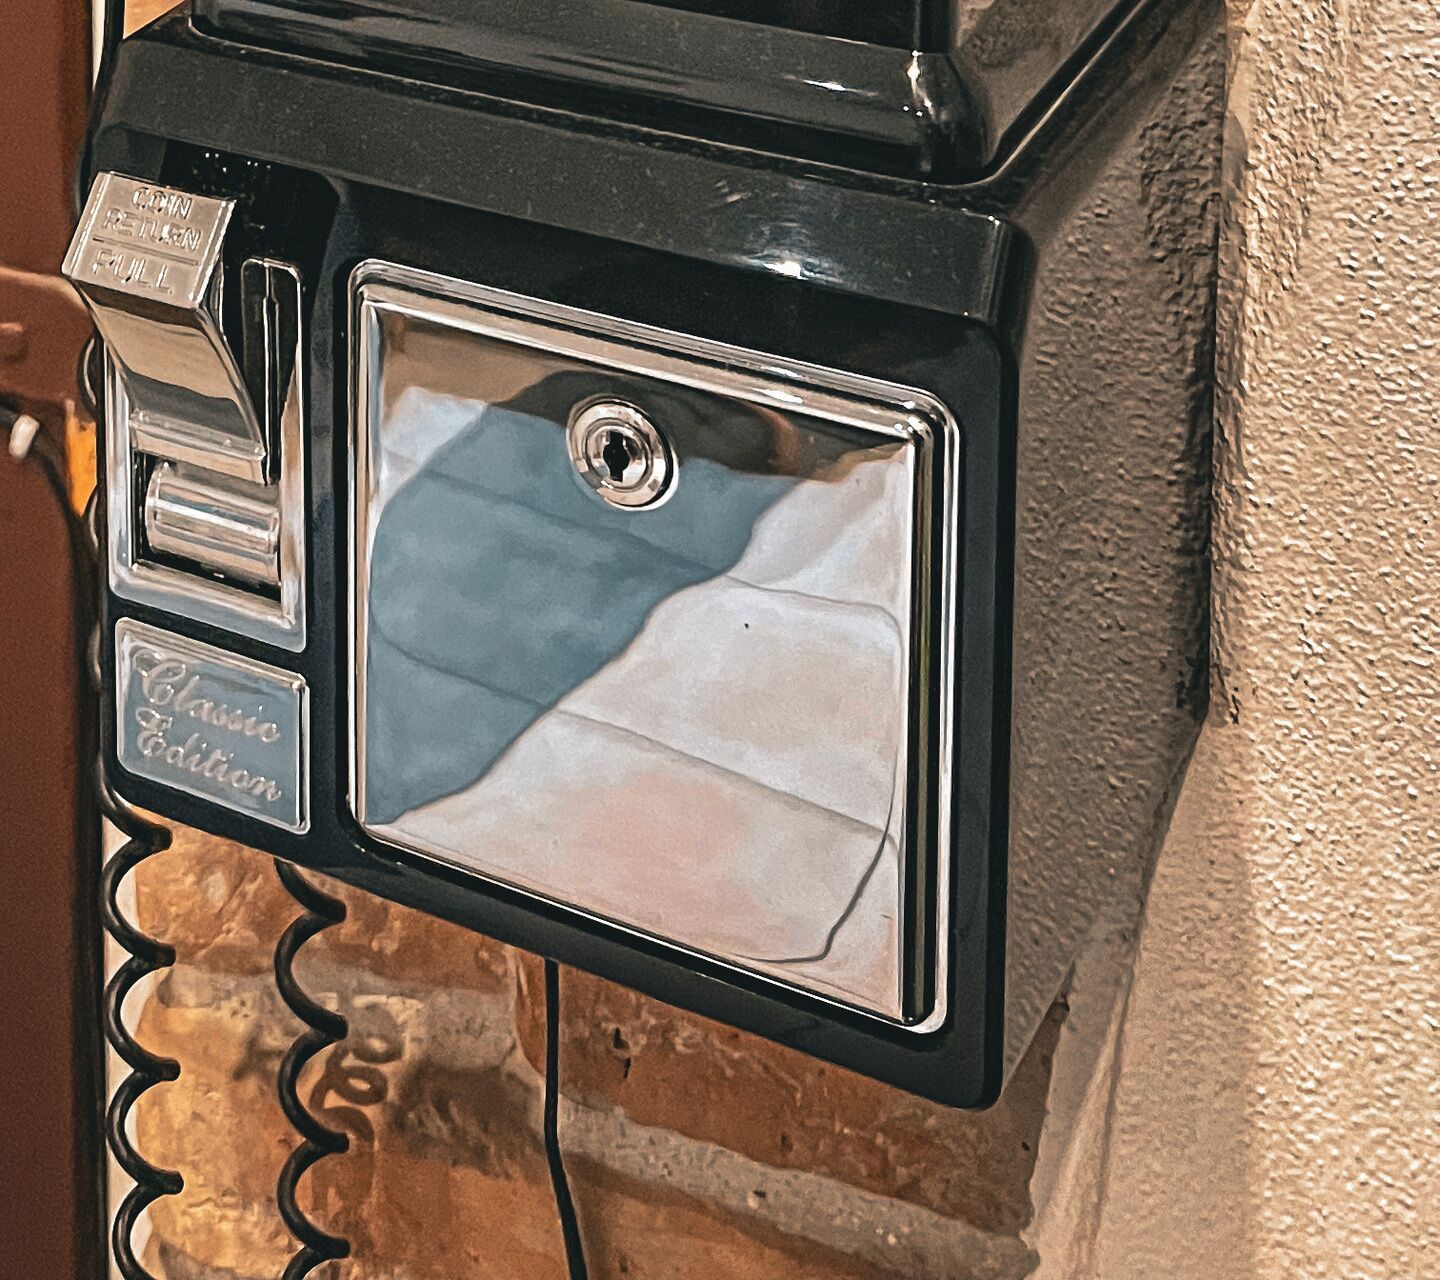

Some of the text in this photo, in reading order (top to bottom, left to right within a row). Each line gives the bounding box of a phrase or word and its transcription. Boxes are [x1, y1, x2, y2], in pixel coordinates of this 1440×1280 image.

[132, 186, 193, 219] COIN
[102, 208, 202, 252] RETURN
[92, 249, 174, 295] PULL
[129, 645, 282, 743] Classic
[135, 706, 282, 802] Edition
